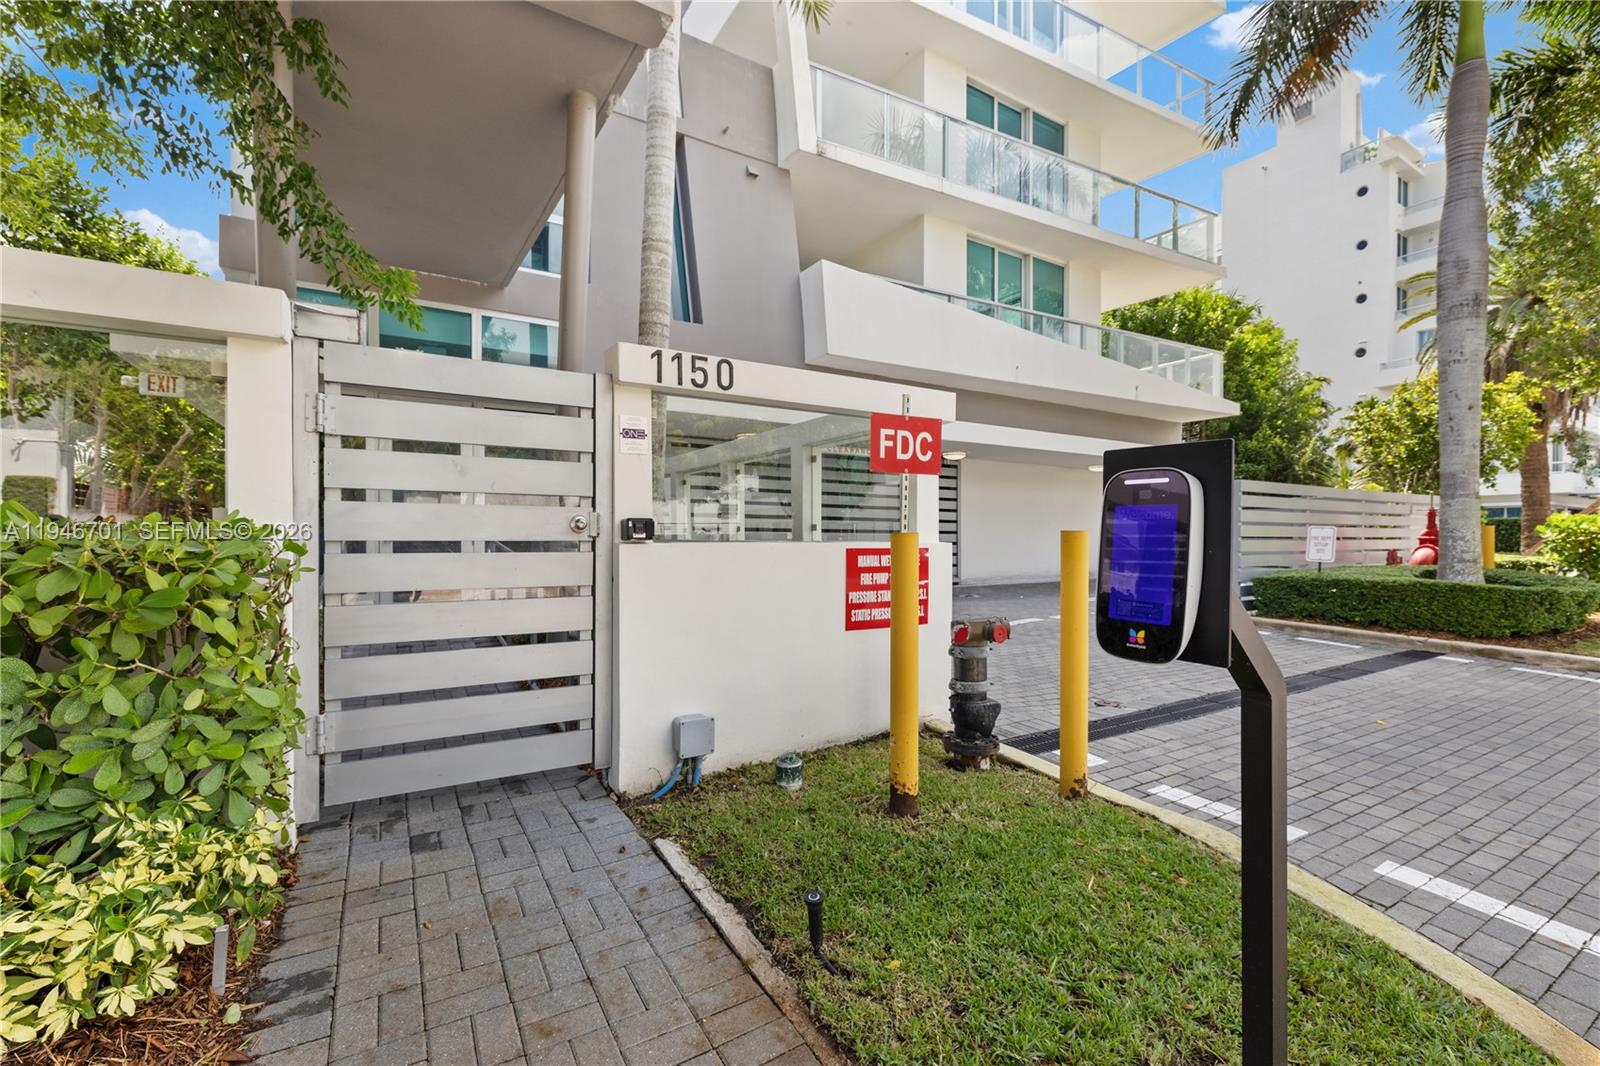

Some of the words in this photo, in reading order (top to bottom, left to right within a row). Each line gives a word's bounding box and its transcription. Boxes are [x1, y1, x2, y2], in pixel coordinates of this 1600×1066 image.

[650, 349, 735, 391] 1150
[147, 374, 177, 393] EXIT
[879, 428, 933, 462] FDC
[857, 554, 881, 567] MANUAL
[860, 573, 873, 585] FIRE
[873, 572, 889, 584] PUMP
[848, 591, 878, 604] PRESSURE
[851, 608, 871, 622] STATIC
